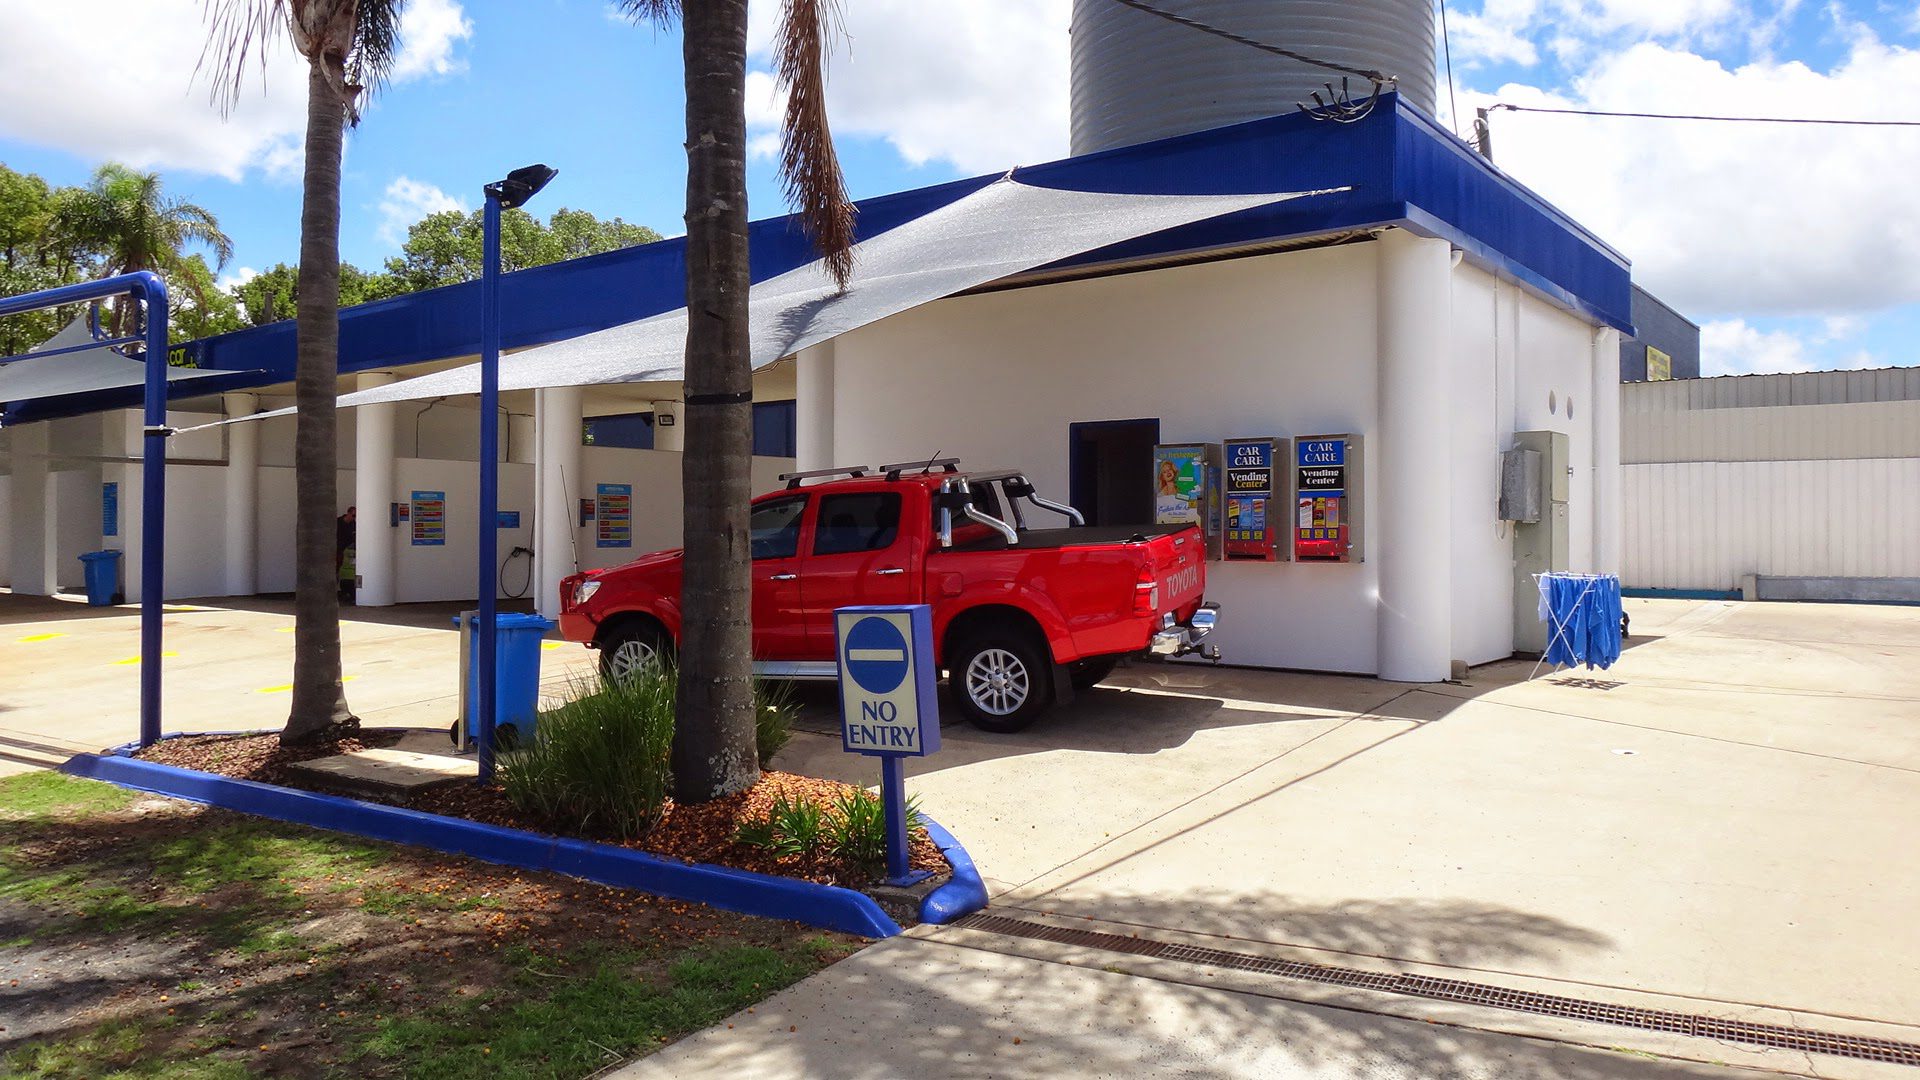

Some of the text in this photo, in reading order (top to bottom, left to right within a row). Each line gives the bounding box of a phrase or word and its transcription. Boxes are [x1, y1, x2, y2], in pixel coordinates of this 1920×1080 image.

[170, 348, 185, 365] car
[1237, 446, 1260, 456] CAR
[1308, 442, 1333, 452] CAR
[1234, 456, 1263, 466] CARE
[1304, 452, 1337, 463] CARE
[1230, 471, 1268, 482] Vending
[1302, 469, 1339, 477] Vending
[1235, 480, 1264, 488] Center
[1306, 477, 1336, 485] Center
[1166, 564, 1198, 599] TOYOTA
[861, 700, 897, 722] NO
[849, 724, 916, 747] ENTRY
